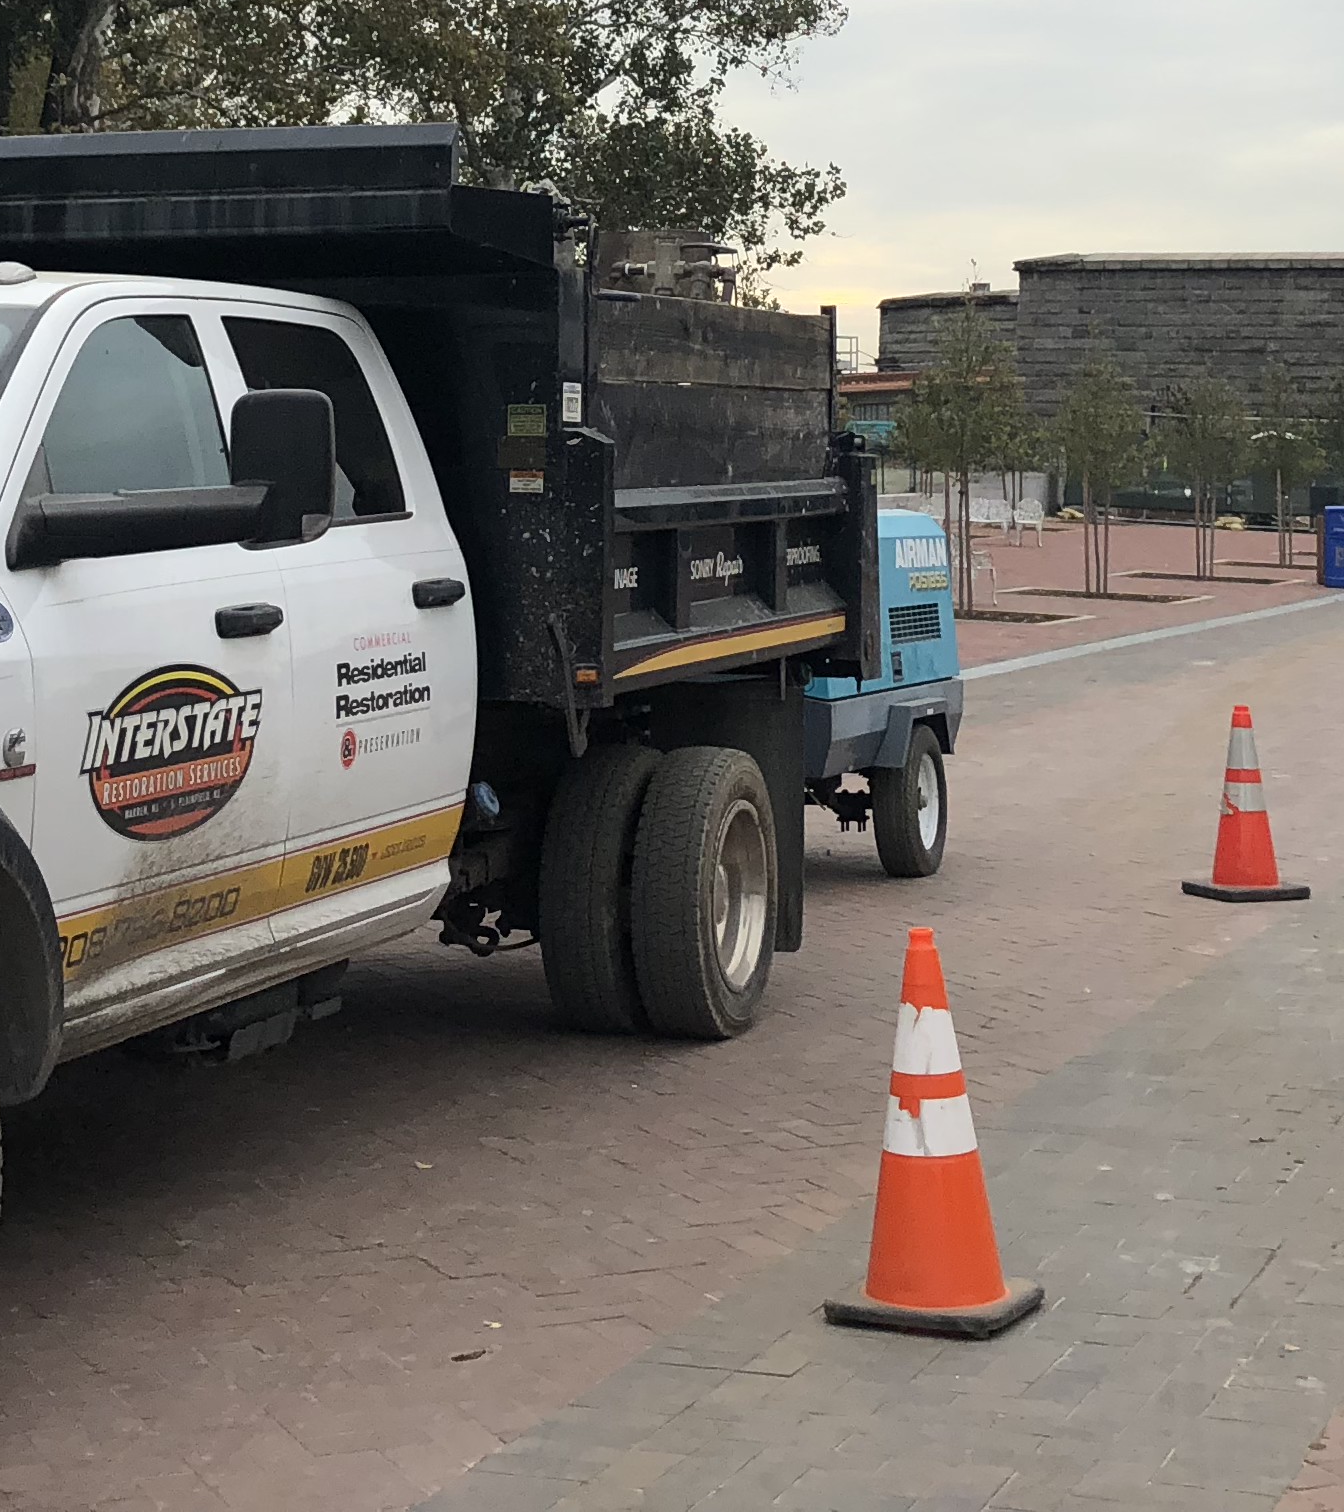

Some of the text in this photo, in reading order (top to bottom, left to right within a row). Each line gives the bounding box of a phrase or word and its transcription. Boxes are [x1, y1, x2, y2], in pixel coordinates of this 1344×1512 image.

[716, 551, 743, 586] Repair
[895, 538, 947, 568] AIRMAN
[354, 632, 412, 651] COMMERCIAL
[336, 651, 426, 687] Residential
[336, 683, 431, 719] Restoration
[82, 692, 262, 771] INTERSTATE
[343, 728, 420, 759] & PRESERVATION
[103, 757, 241, 805] RESTORATION SERVICES
[168, 885, 242, 933] 8200
